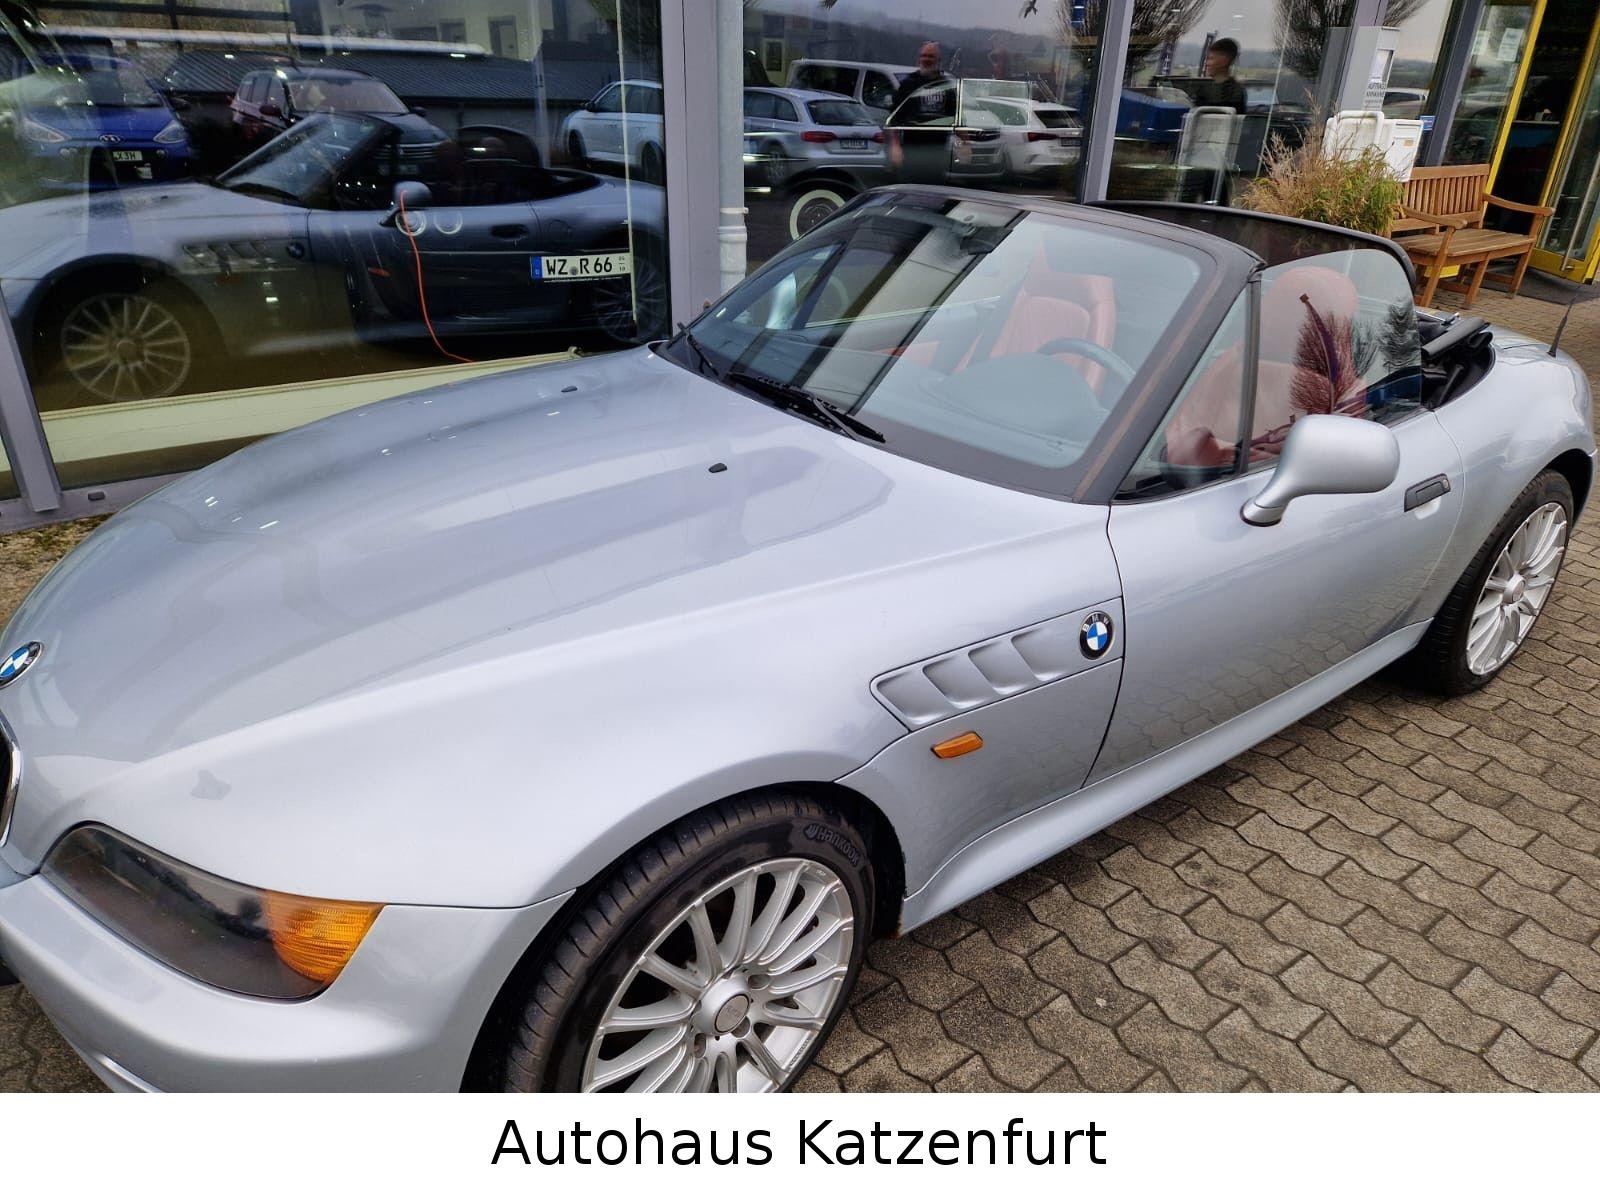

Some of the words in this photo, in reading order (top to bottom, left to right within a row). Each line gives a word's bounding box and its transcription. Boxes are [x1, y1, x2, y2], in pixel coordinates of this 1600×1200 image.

[546, 258, 568, 275] WZ
[579, 258, 590, 274] R
[593, 256, 613, 273] 66
[1081, 613, 1110, 633] BMW
